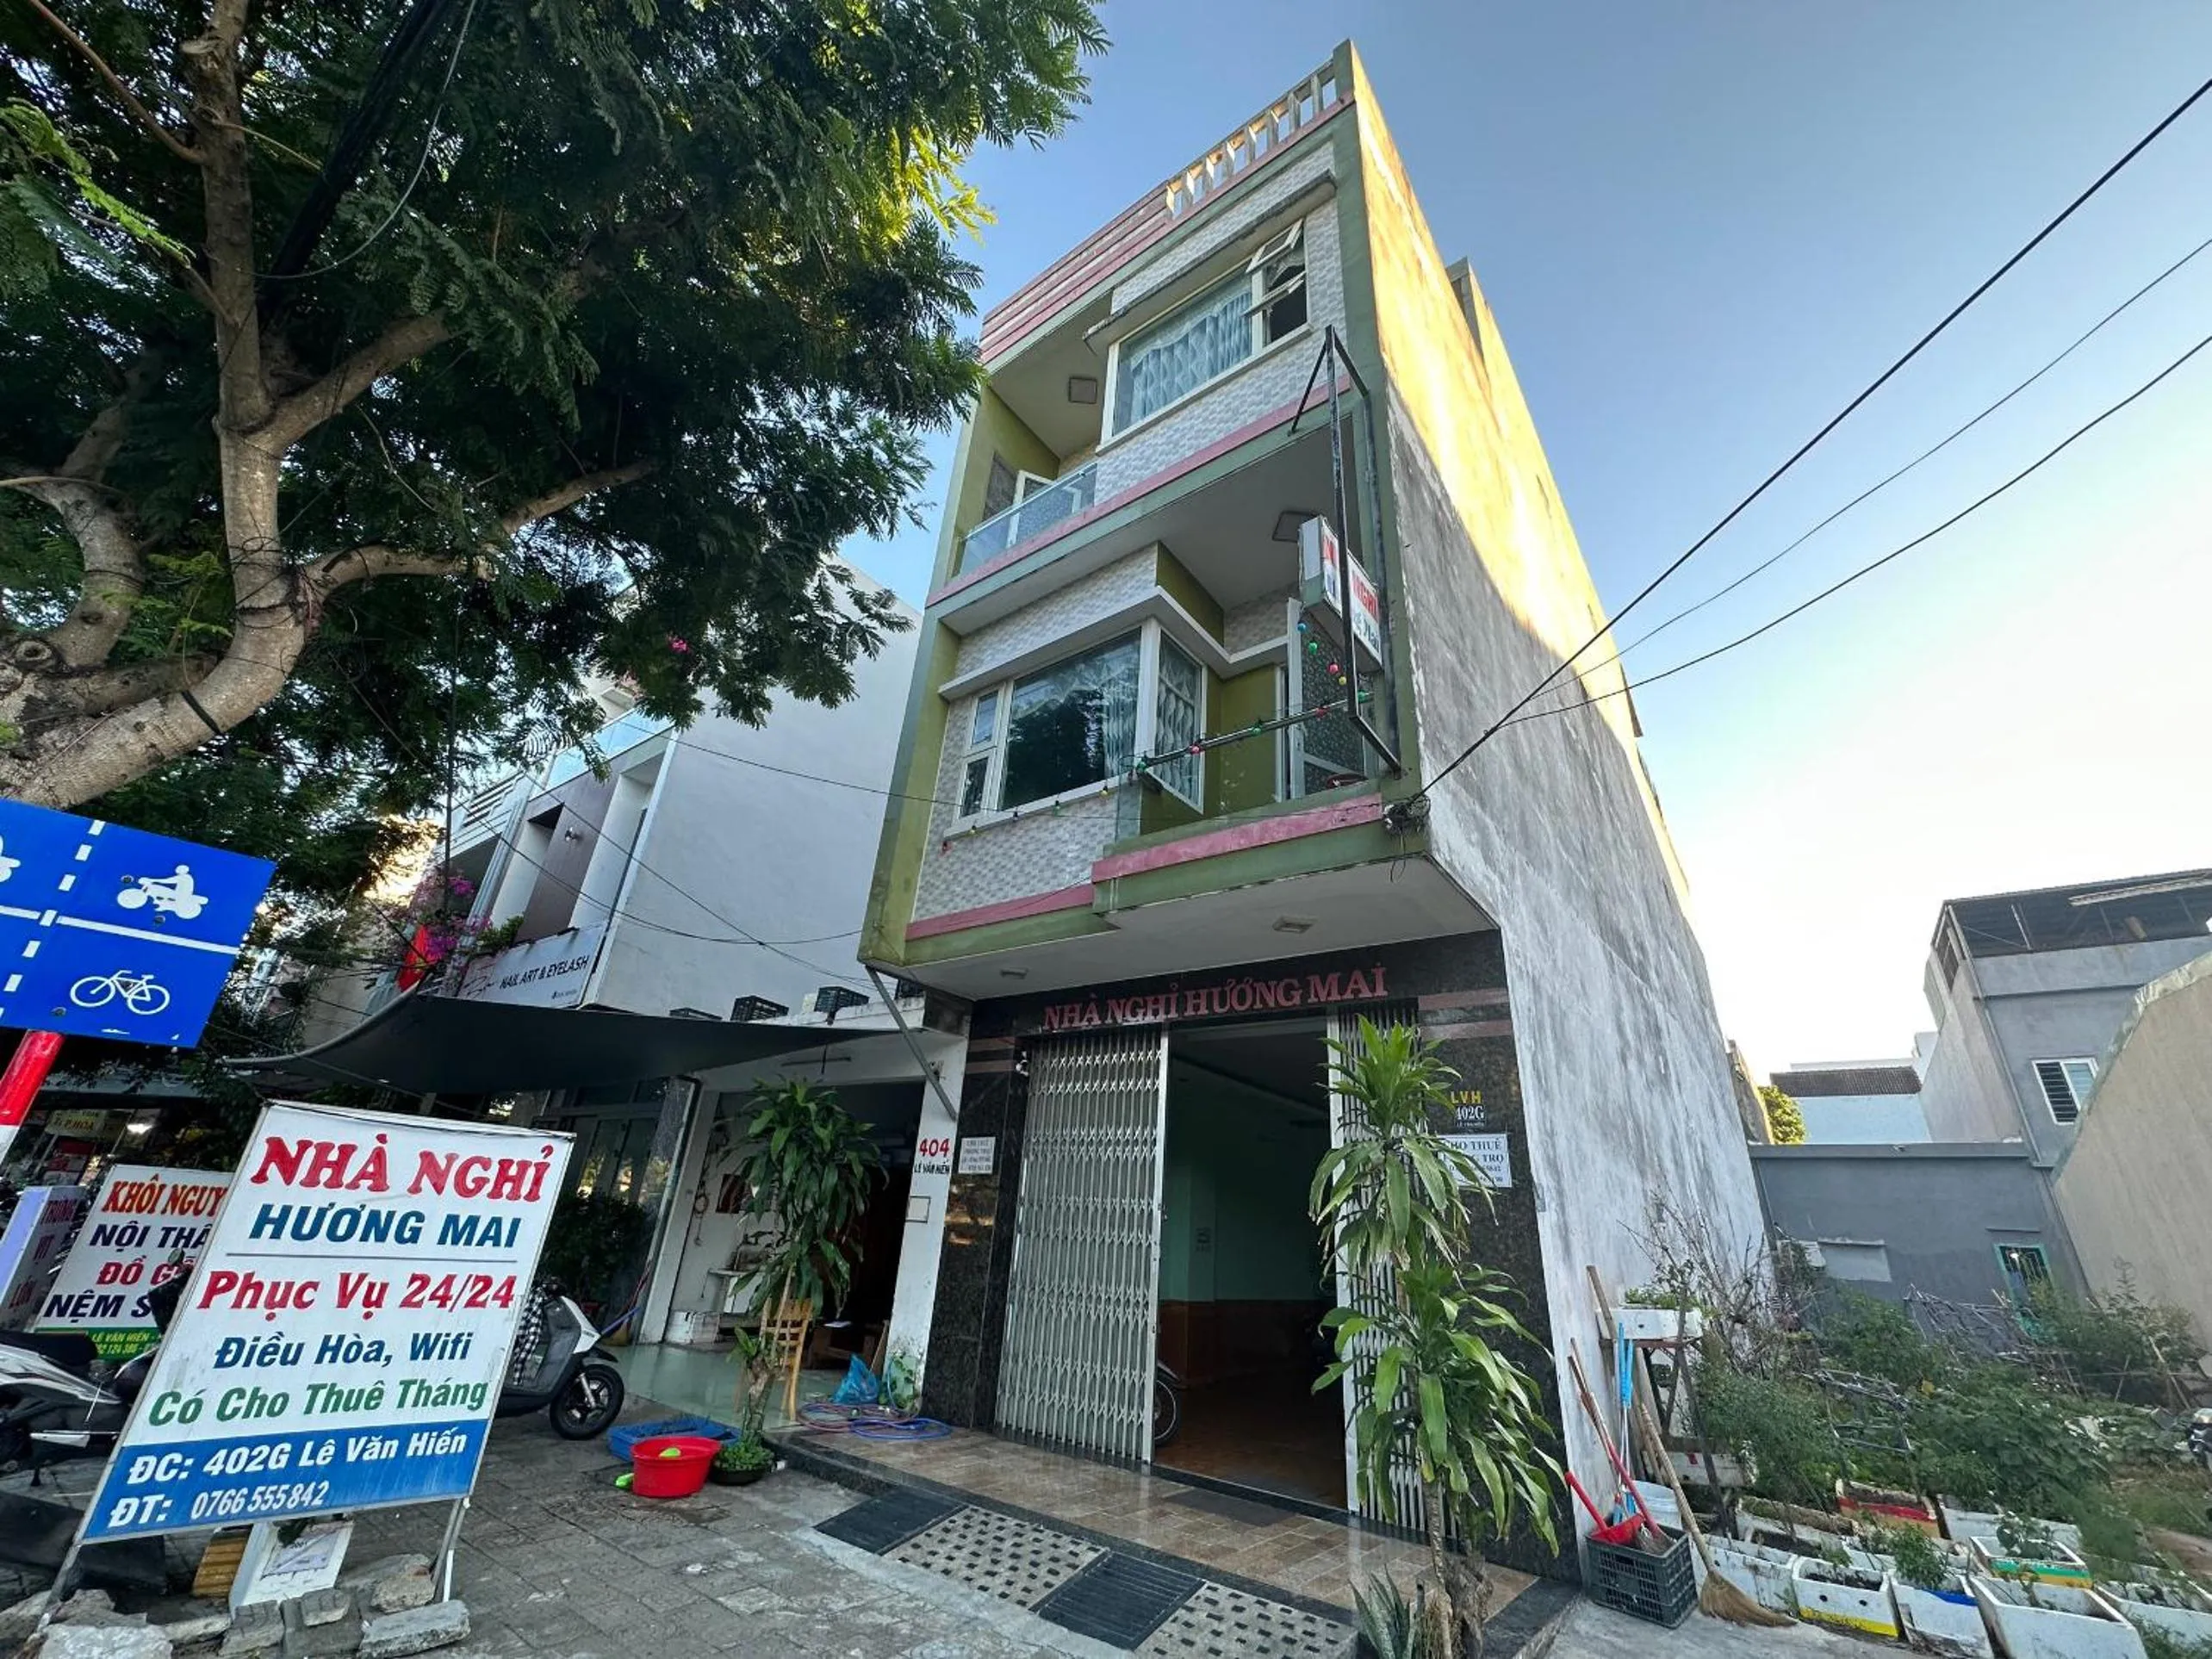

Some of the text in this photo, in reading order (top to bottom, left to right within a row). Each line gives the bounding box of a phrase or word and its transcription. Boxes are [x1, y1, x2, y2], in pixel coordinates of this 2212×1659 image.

[546, 955, 590, 979] EYELASH
[1042, 992, 1101, 1030] NHÀ
[1105, 982, 1178, 1024] NGHỈ
[1457, 1105, 1484, 1120] 402G
[251, 1134, 553, 1202] NHÀ NGHỈ
[919, 1138, 949, 1158] 404
[101, 1173, 228, 1217] KHÔI NGUY
[89, 1220, 214, 1252] NỘI THÂ
[249, 1202, 521, 1248] HƯƠNG MAI
[43, 1289, 126, 1323] NỆM
[196, 1271, 320, 1320] Phục
[336, 1273, 389, 1320] Vụ
[399, 1273, 517, 1313] 24/24
[214, 1330, 473, 1370] Điều Hòa, Wifi
[148, 1376, 488, 1426] Có Cho Thuê Tháng
[127, 1426, 466, 1485] ĐC: 402G Lê Văn Hiến
[107, 1494, 173, 1528] ĐT:
